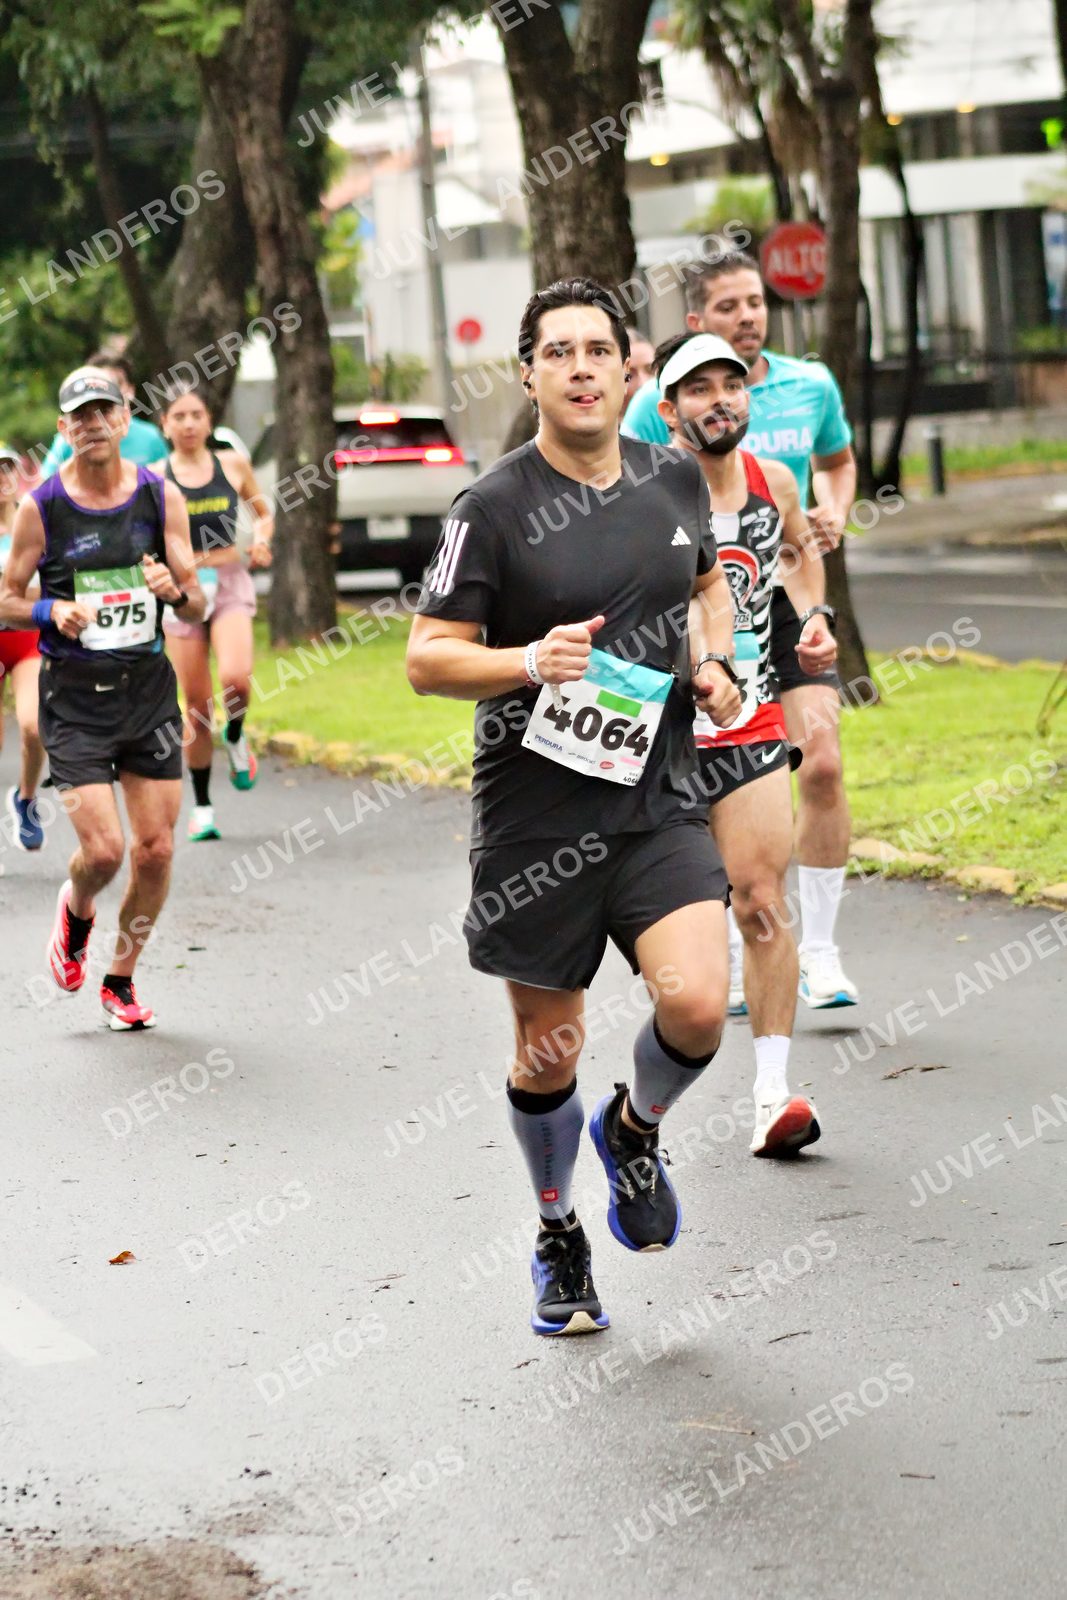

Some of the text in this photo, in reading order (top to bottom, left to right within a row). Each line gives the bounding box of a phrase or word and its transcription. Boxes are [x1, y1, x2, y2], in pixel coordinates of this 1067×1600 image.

[766, 244, 826, 277] ALTO
[96, 602, 147, 629] 675
[543, 695, 649, 757] 4064
[534, 734, 563, 752] PERDURA
